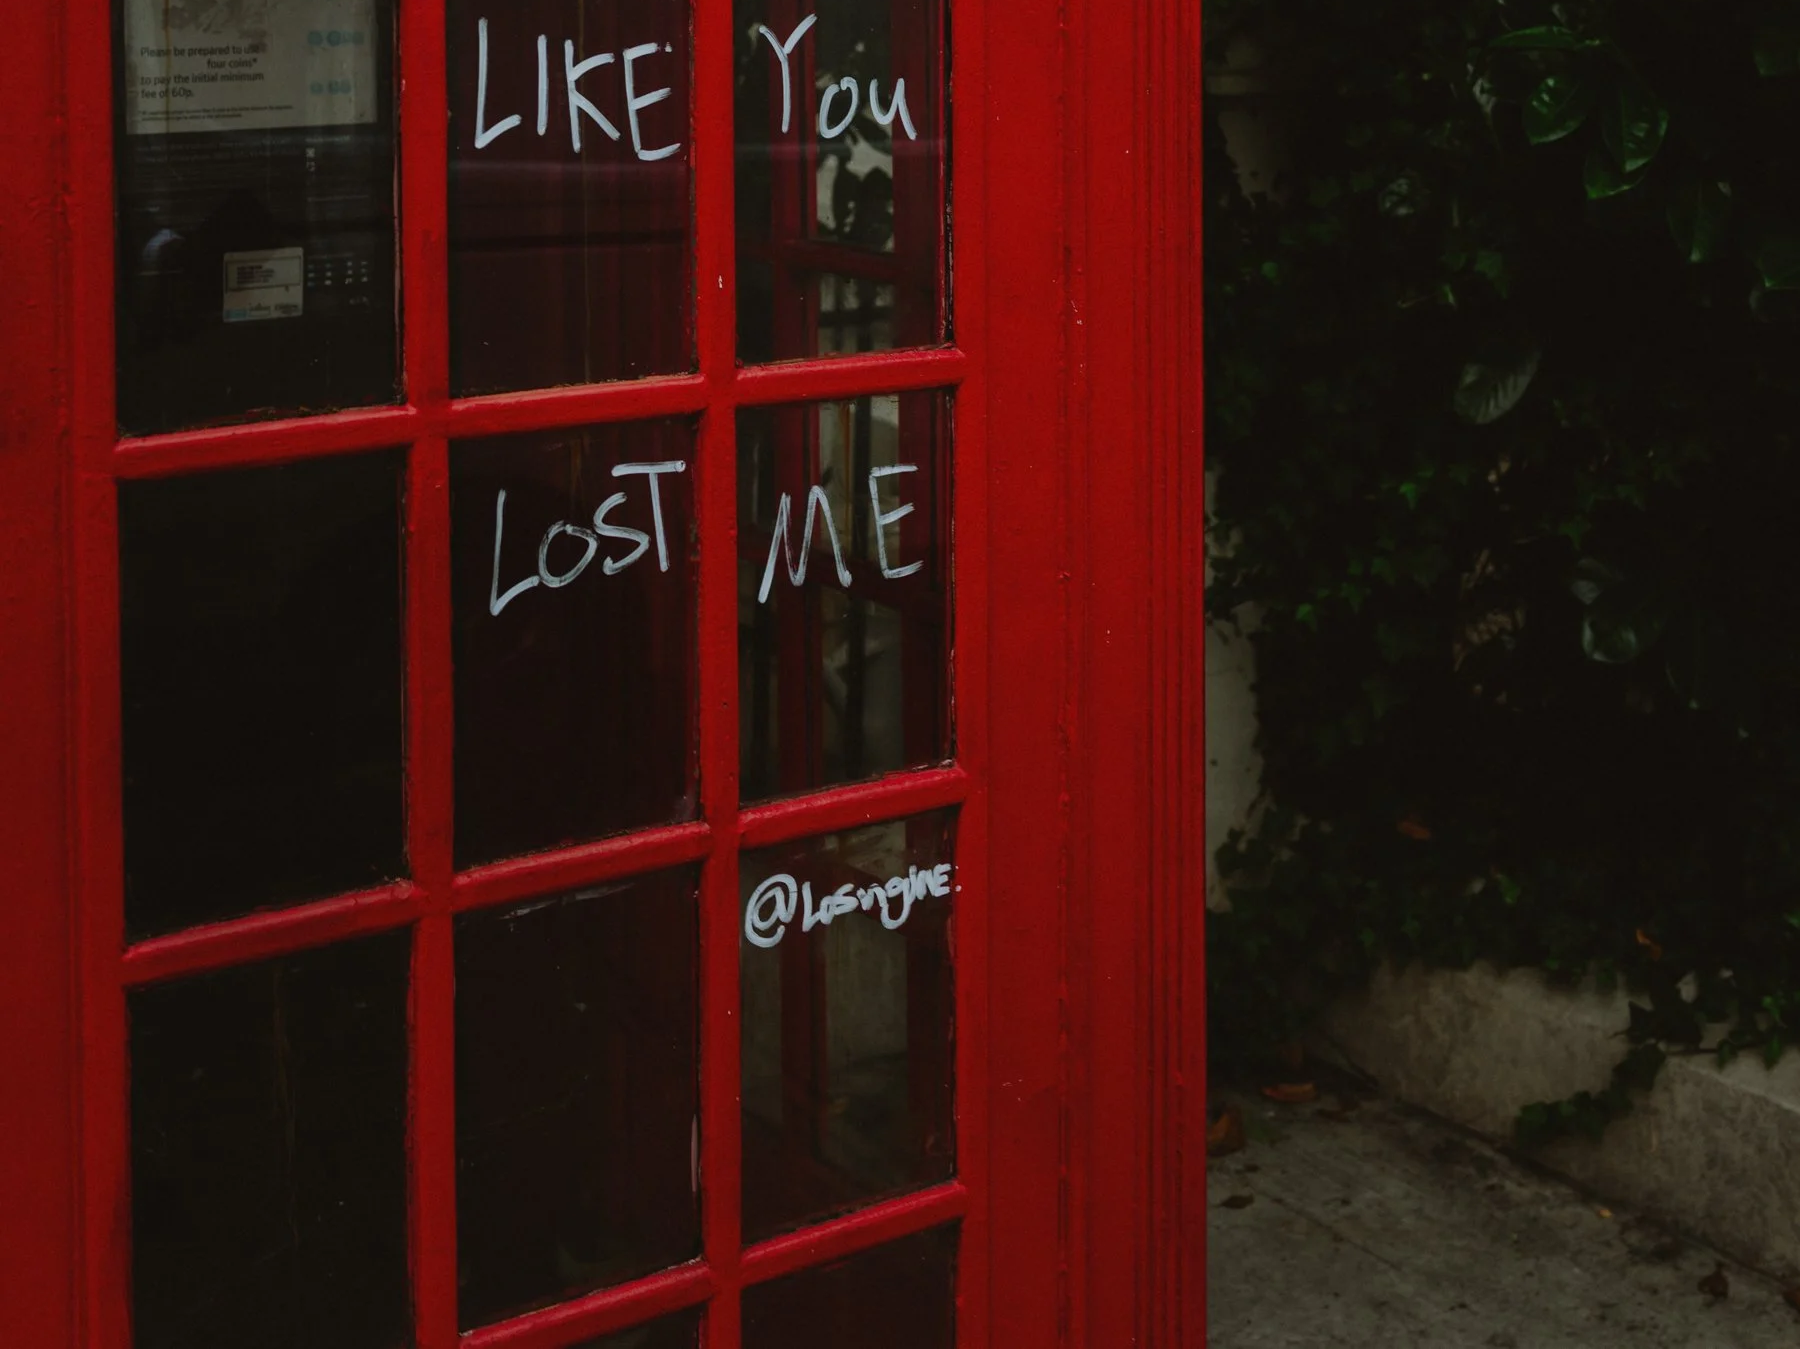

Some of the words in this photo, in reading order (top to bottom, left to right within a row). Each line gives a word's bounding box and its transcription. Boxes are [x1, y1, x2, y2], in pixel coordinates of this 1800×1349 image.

[140, 46, 171, 57] Please
[173, 45, 185, 57] be
[187, 44, 230, 58] prepared
[232, 45, 242, 55] to
[207, 58, 226, 69] four
[140, 76, 152, 86] to
[153, 75, 171, 88] pay
[173, 73, 190, 84] the
[191, 72, 218, 84] initial
[220, 72, 264, 82] minimum
[141, 88, 157, 99] fee
[159, 88, 170, 99] of
[474, 16, 683, 162] LIKE
[757, 462, 925, 604] ME
